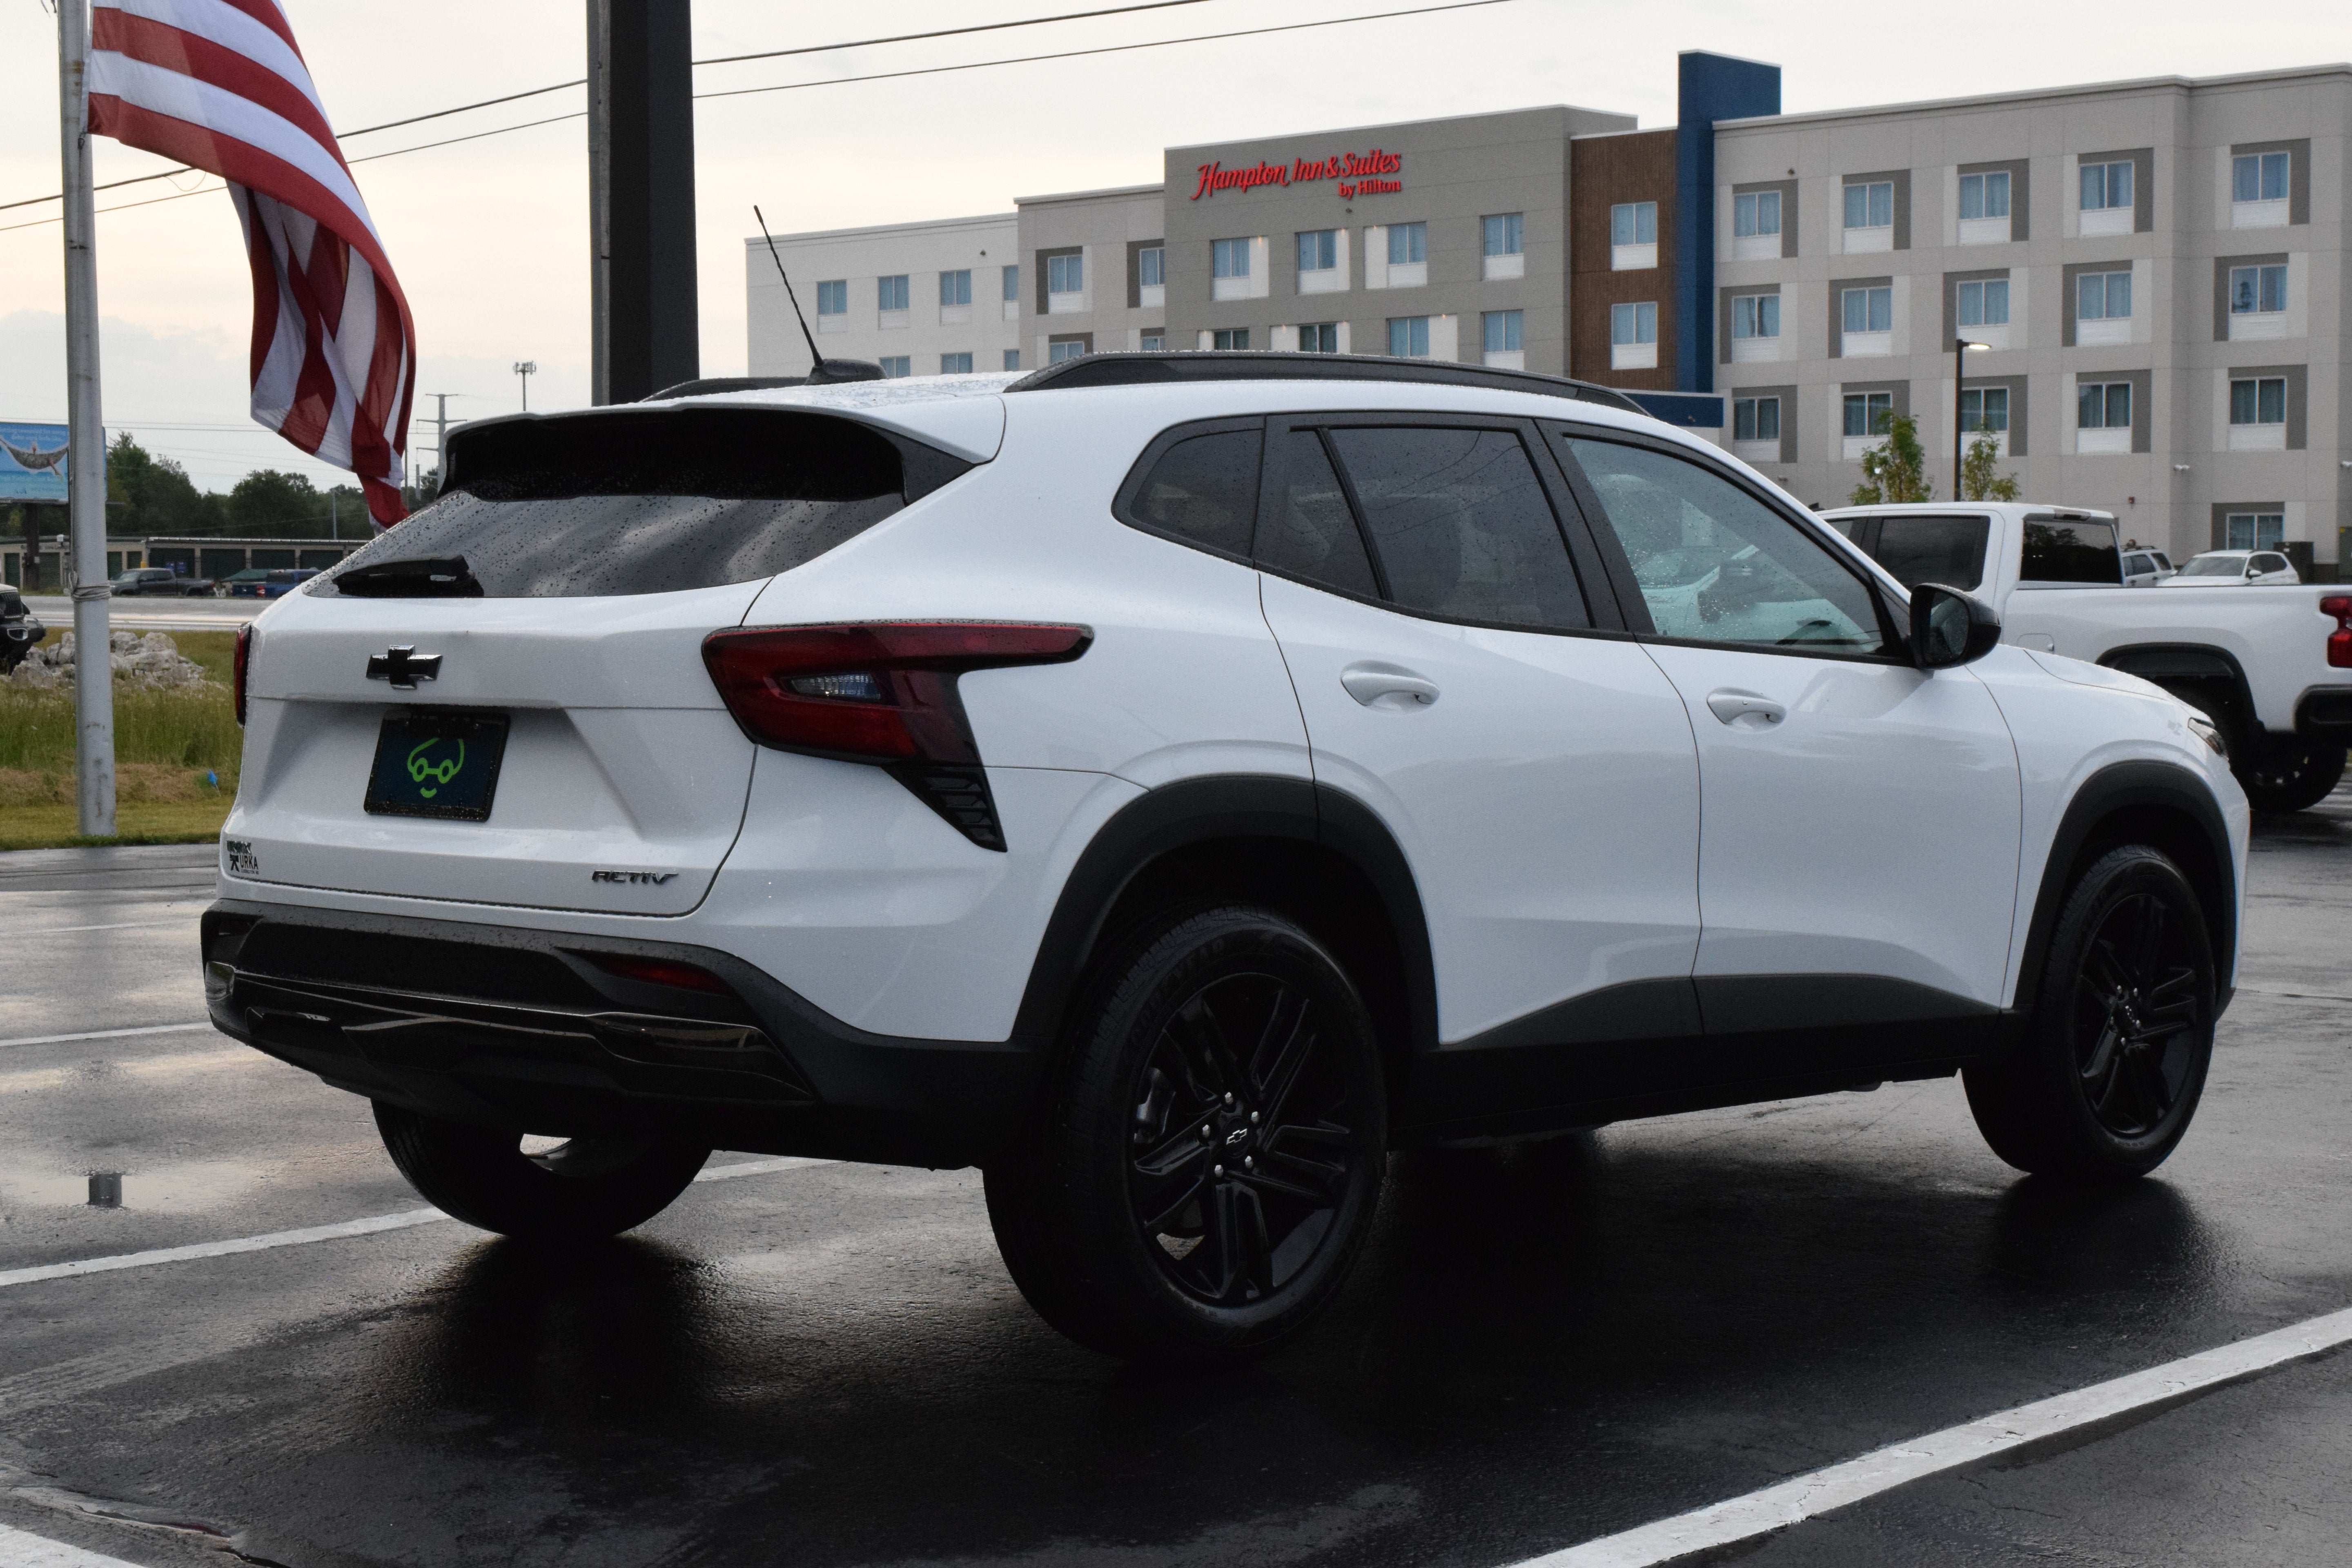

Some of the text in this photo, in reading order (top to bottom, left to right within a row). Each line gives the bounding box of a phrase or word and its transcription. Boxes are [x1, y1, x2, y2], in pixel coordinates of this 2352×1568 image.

[1190, 161, 1289, 200] Hampton
[1338, 178, 1401, 200] by Hilton
[592, 870, 679, 885] ACTIV
